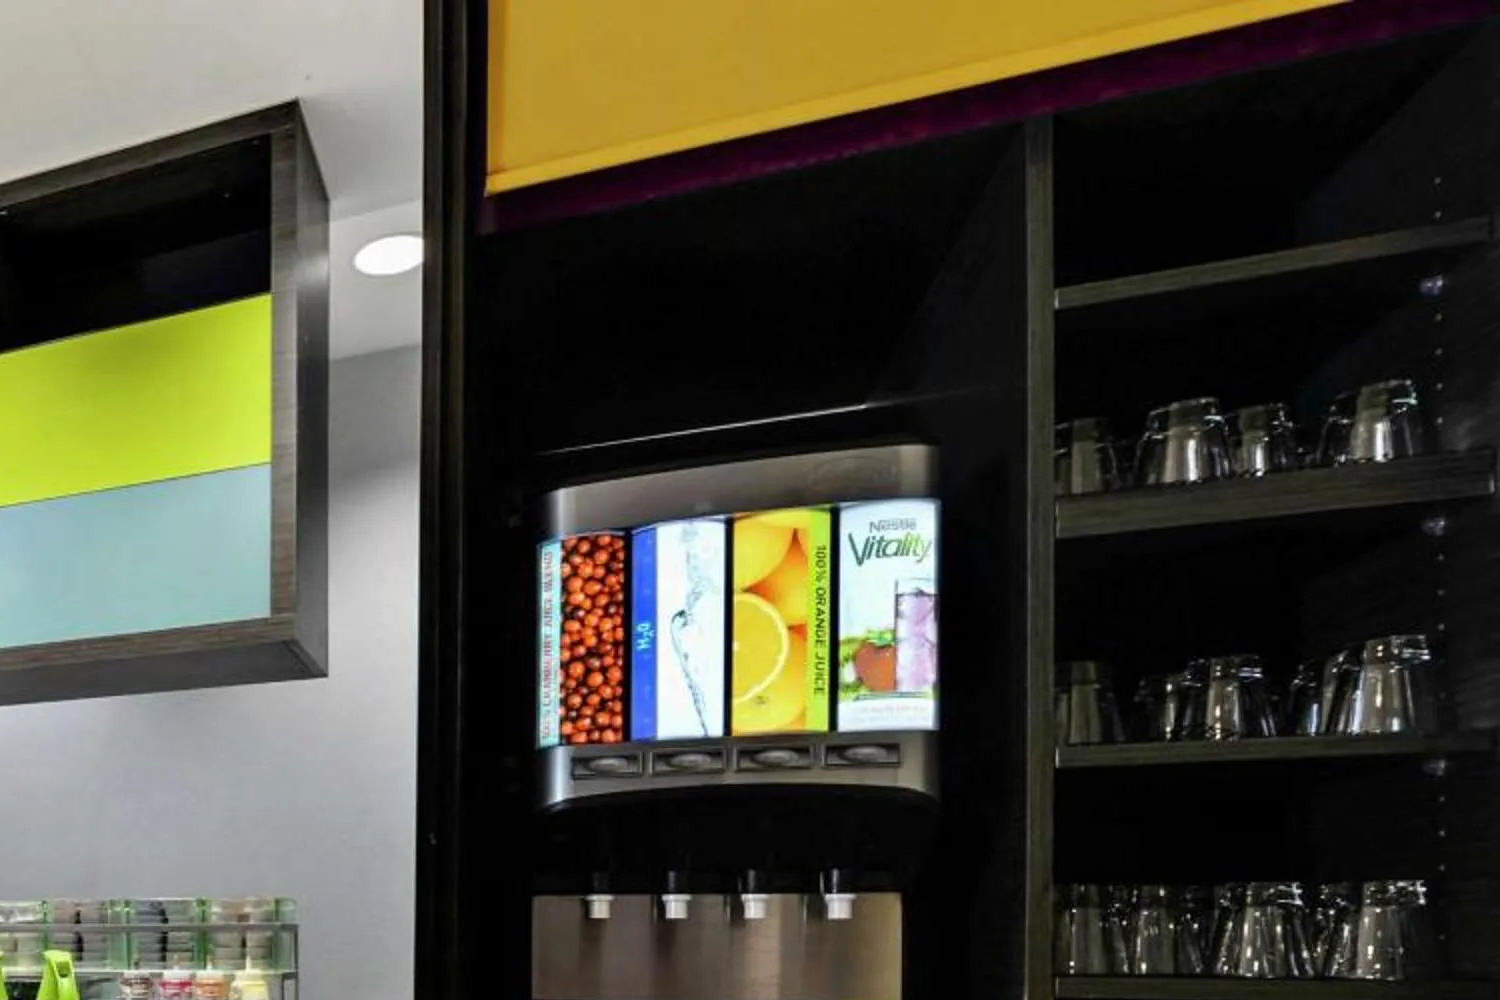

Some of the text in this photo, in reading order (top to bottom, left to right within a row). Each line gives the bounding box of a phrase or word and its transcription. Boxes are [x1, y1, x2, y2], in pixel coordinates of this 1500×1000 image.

[815, 544, 827, 582] 100%
[848, 532, 932, 567] Vitality
[814, 652, 826, 695] JUICE
